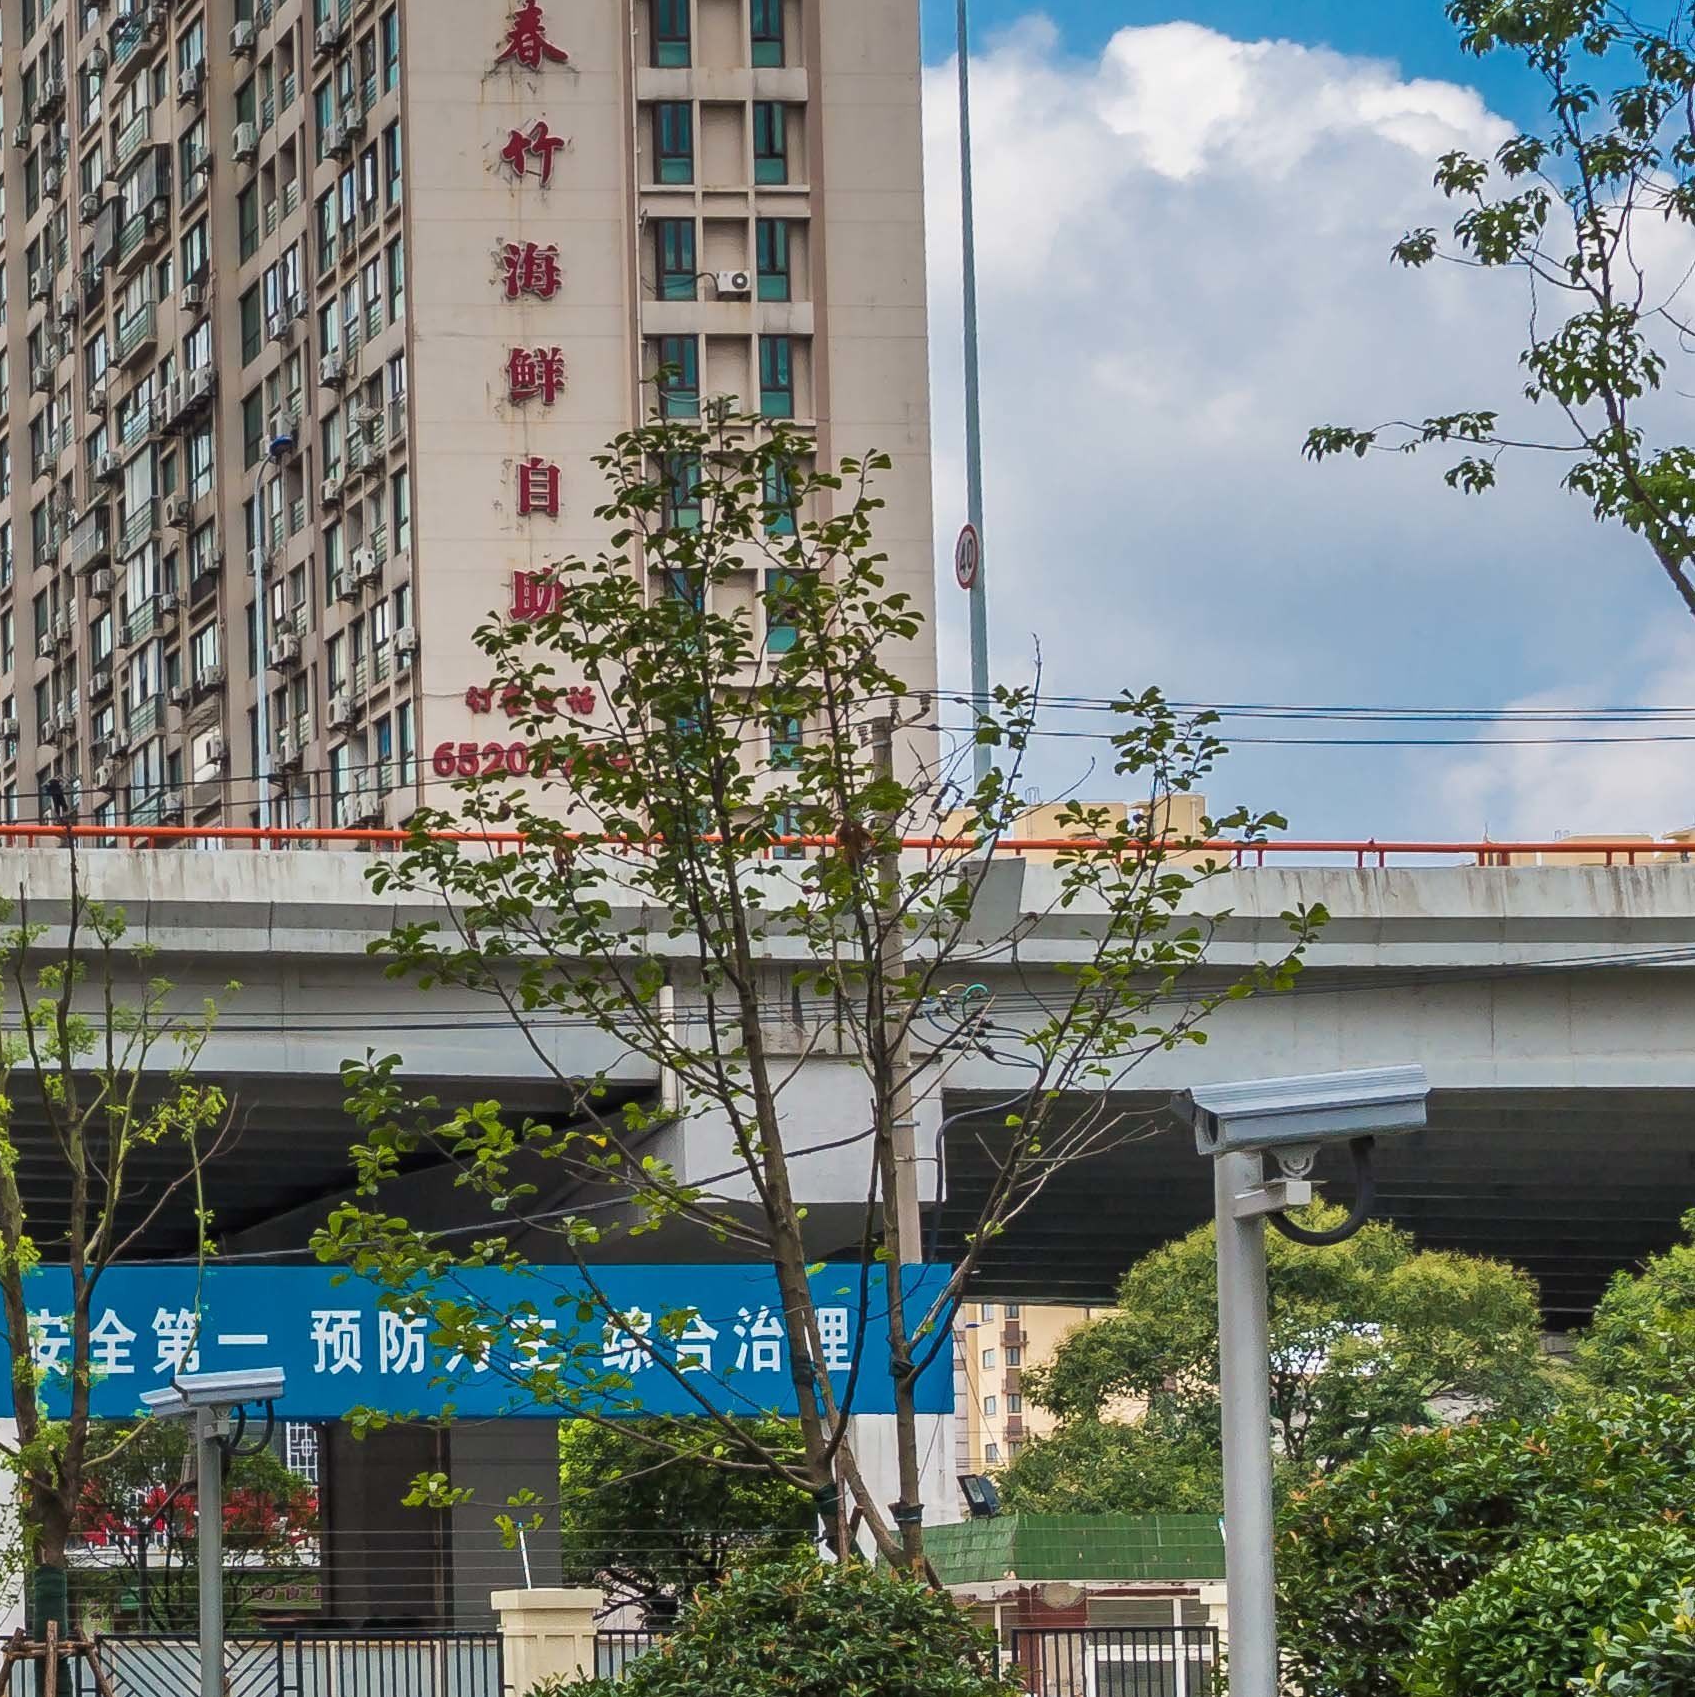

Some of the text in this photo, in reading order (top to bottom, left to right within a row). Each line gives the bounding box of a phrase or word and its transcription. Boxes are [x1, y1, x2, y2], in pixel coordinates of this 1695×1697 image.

[959, 537, 973, 573] 40
[24, 1304, 854, 1375] 安全第一 预防为主 综合治理
